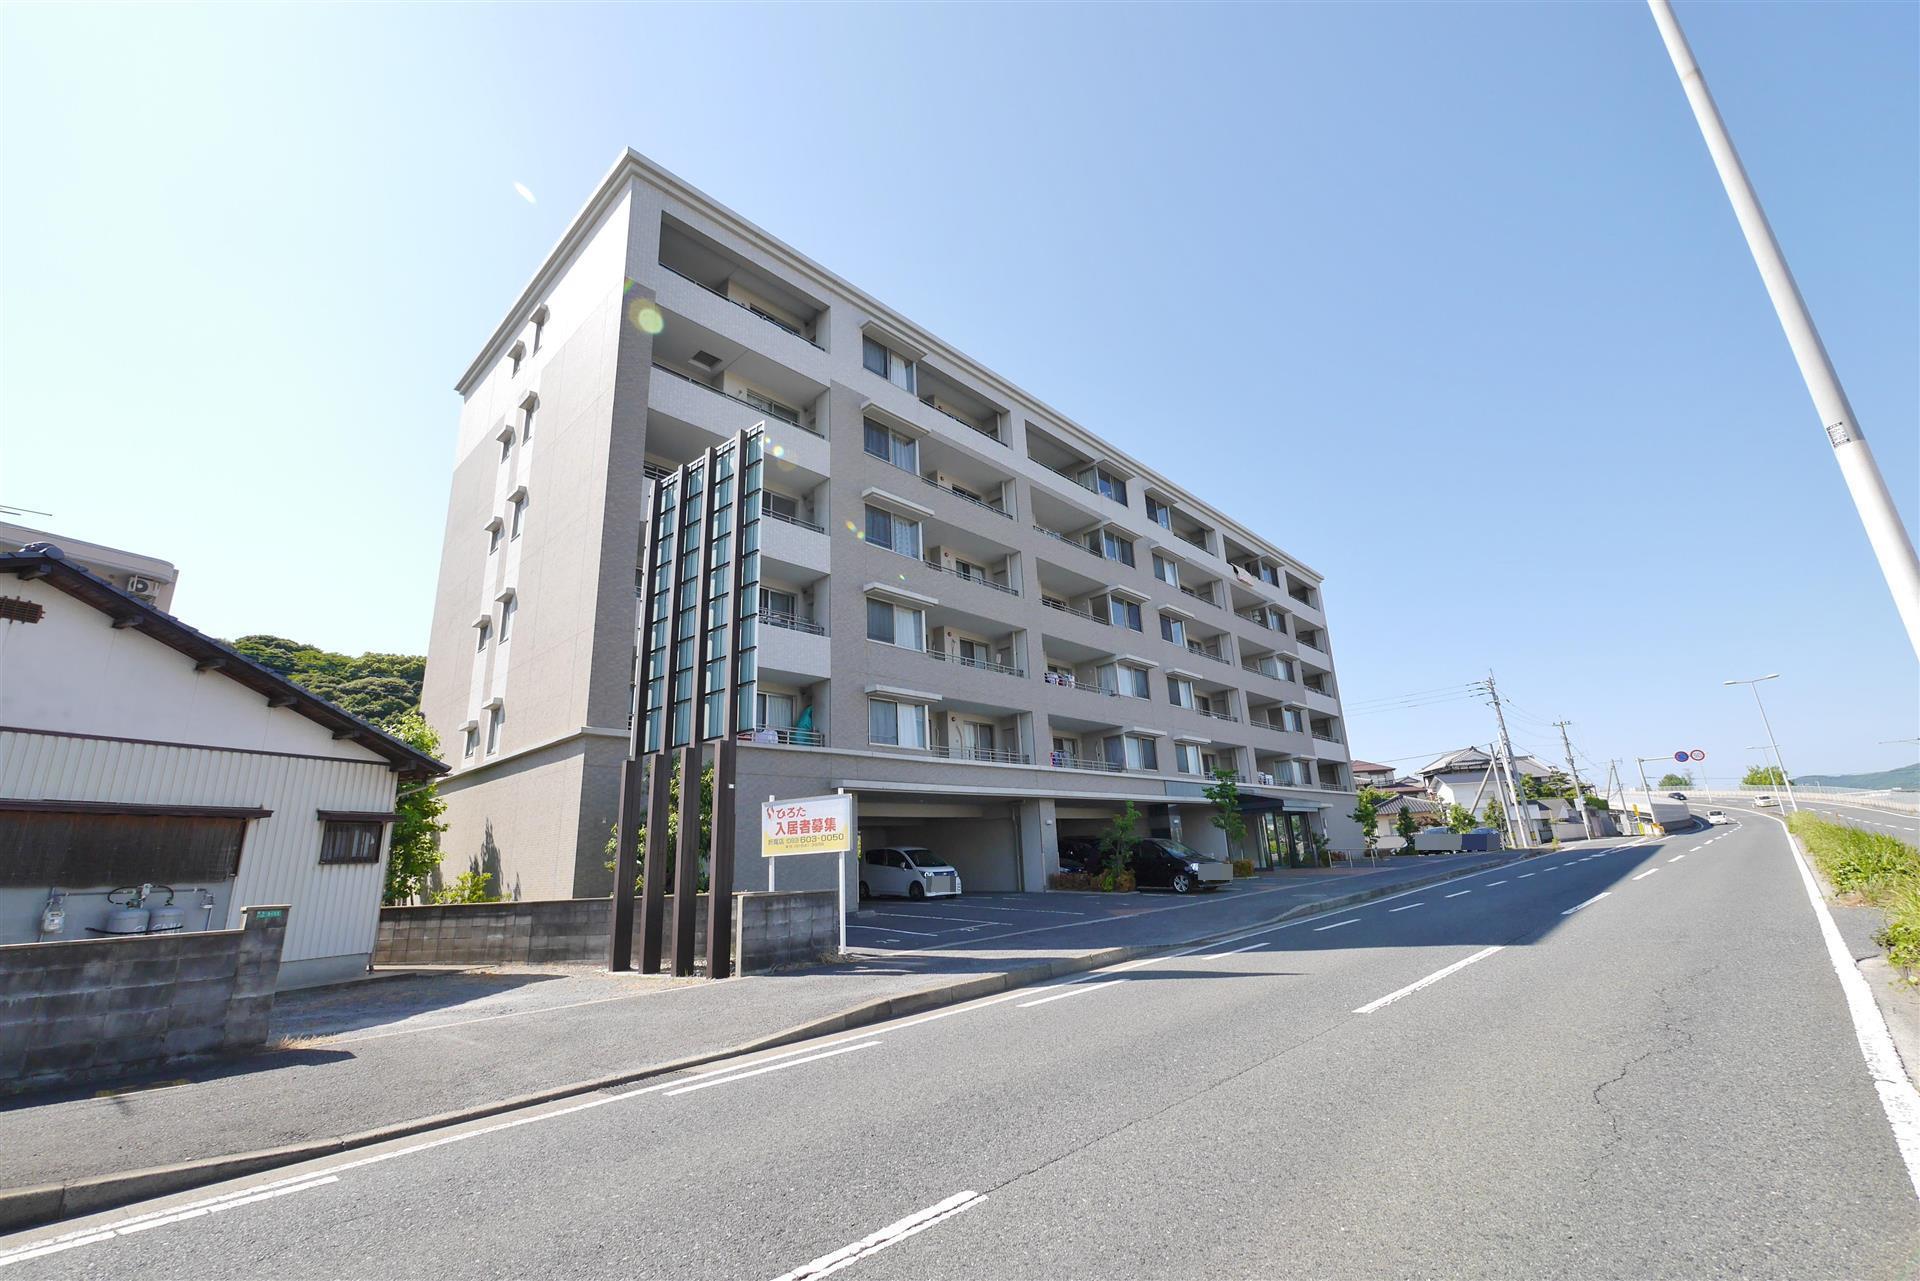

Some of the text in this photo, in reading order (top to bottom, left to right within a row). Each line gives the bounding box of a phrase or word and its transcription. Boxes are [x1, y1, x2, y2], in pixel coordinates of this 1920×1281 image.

[776, 806, 807, 819] ひろた
[775, 817, 836, 836] 入居者募集
